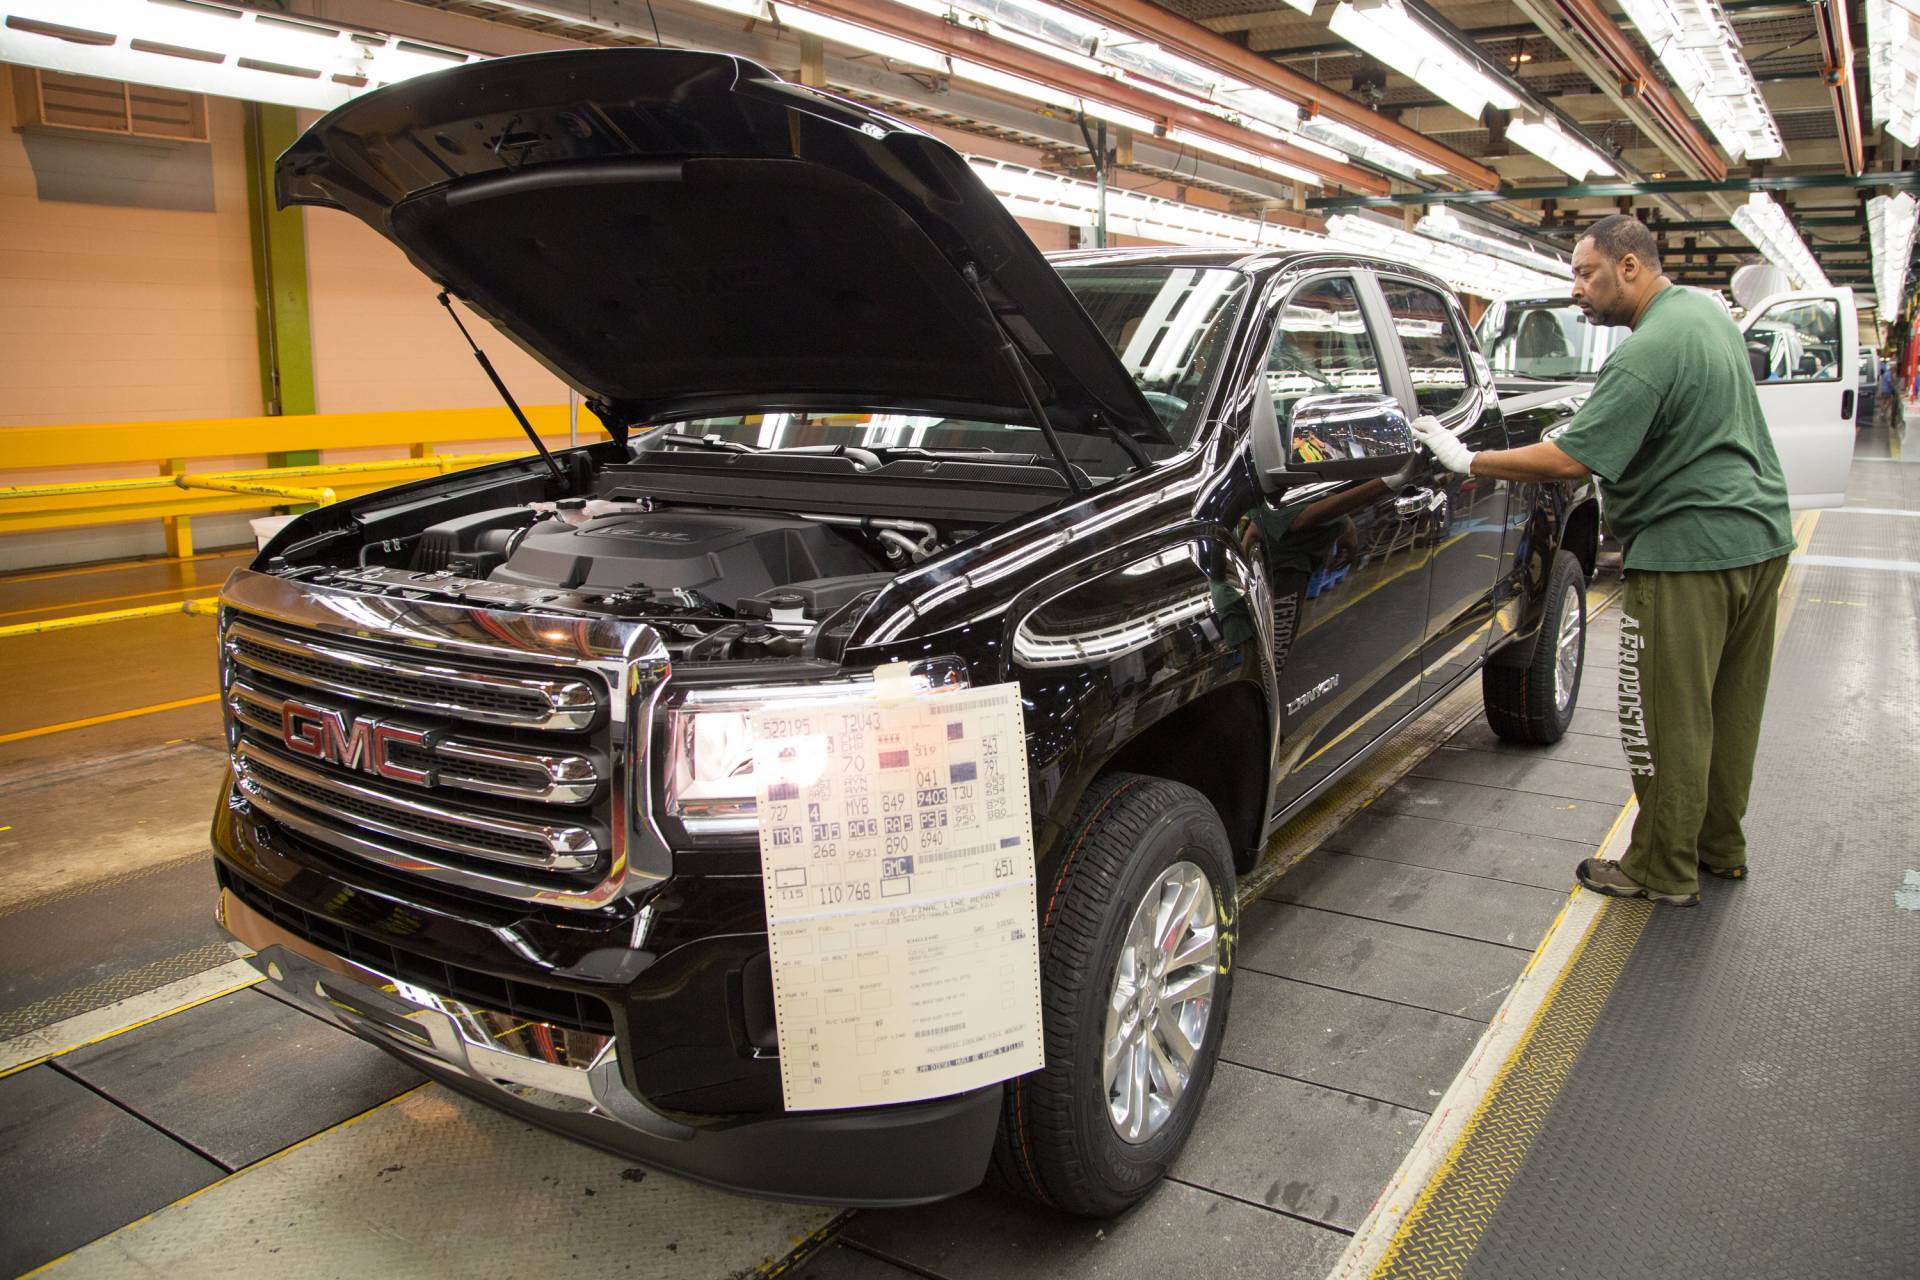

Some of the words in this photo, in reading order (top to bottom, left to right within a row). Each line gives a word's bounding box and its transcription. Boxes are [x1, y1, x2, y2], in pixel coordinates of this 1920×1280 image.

[281, 699, 438, 789] GMC
[842, 754, 865, 773] 70
[916, 769, 938, 787] 041
[917, 788, 948, 807] 9403
[953, 784, 974, 800] T3U
[846, 797, 869, 817] MYB
[882, 793, 905, 812] 849
[808, 804, 820, 822] 4
[920, 812, 936, 829] PS
[938, 810, 948, 826] F
[812, 824, 830, 841] FU
[848, 820, 866, 838] AC
[867, 819, 878, 836] 3
[884, 816, 901, 833] RA
[773, 827, 791, 845] TR
[792, 826, 803, 843] A
[886, 835, 908, 855] 890
[921, 830, 943, 848] 6940
[883, 858, 908, 878] GMC
[995, 859, 1014, 878] 651
[820, 885, 842, 905] 110
[847, 882, 871, 901] 768
